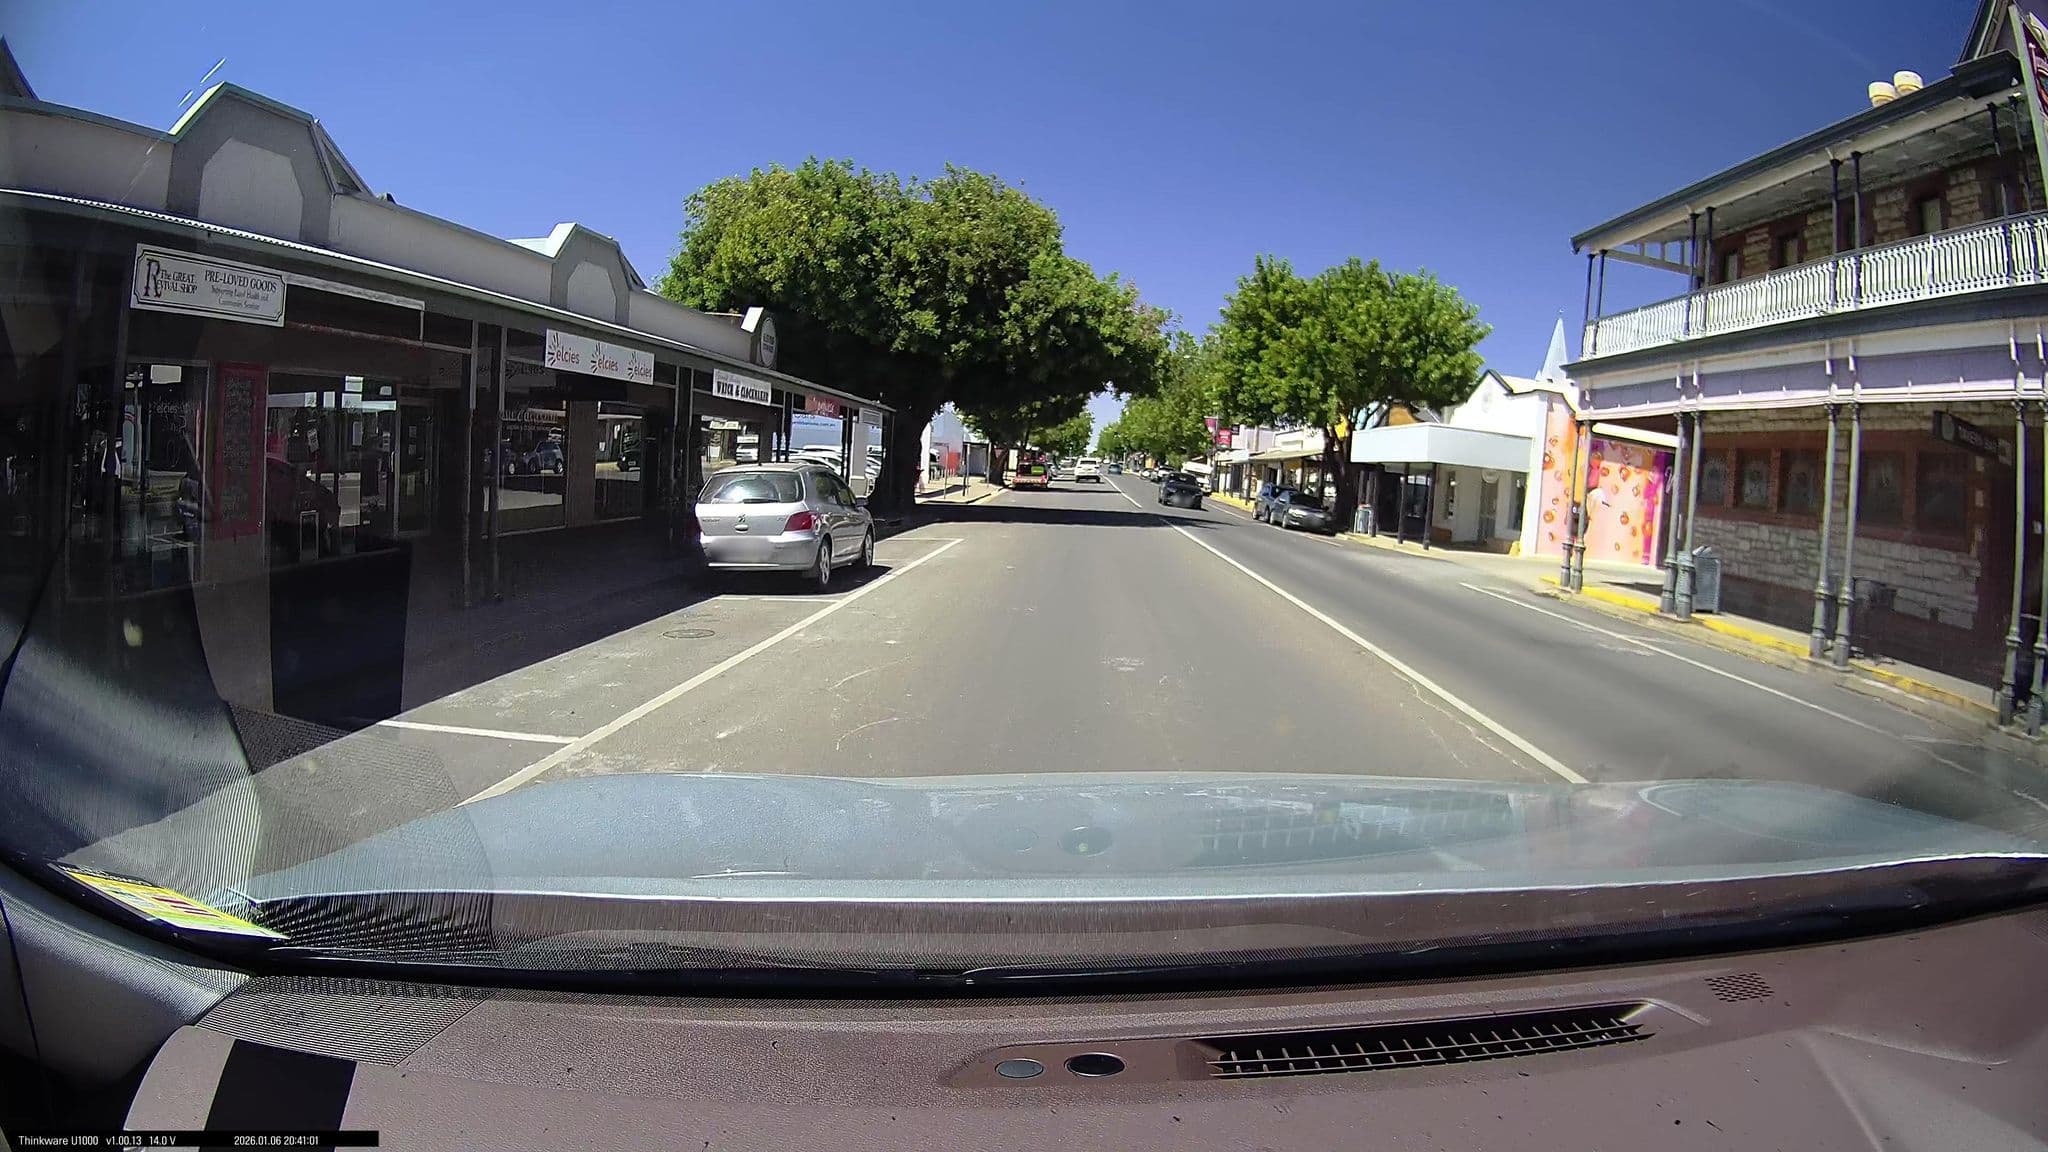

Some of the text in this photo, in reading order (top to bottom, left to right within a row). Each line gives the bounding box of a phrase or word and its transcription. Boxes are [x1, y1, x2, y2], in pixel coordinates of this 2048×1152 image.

[172, 271, 195, 282] GREAT
[204, 270, 277, 293] PRE-LOVED GOODS
[181, 284, 198, 294] SHOP
[556, 346, 652, 378] elcies elcies elcies
